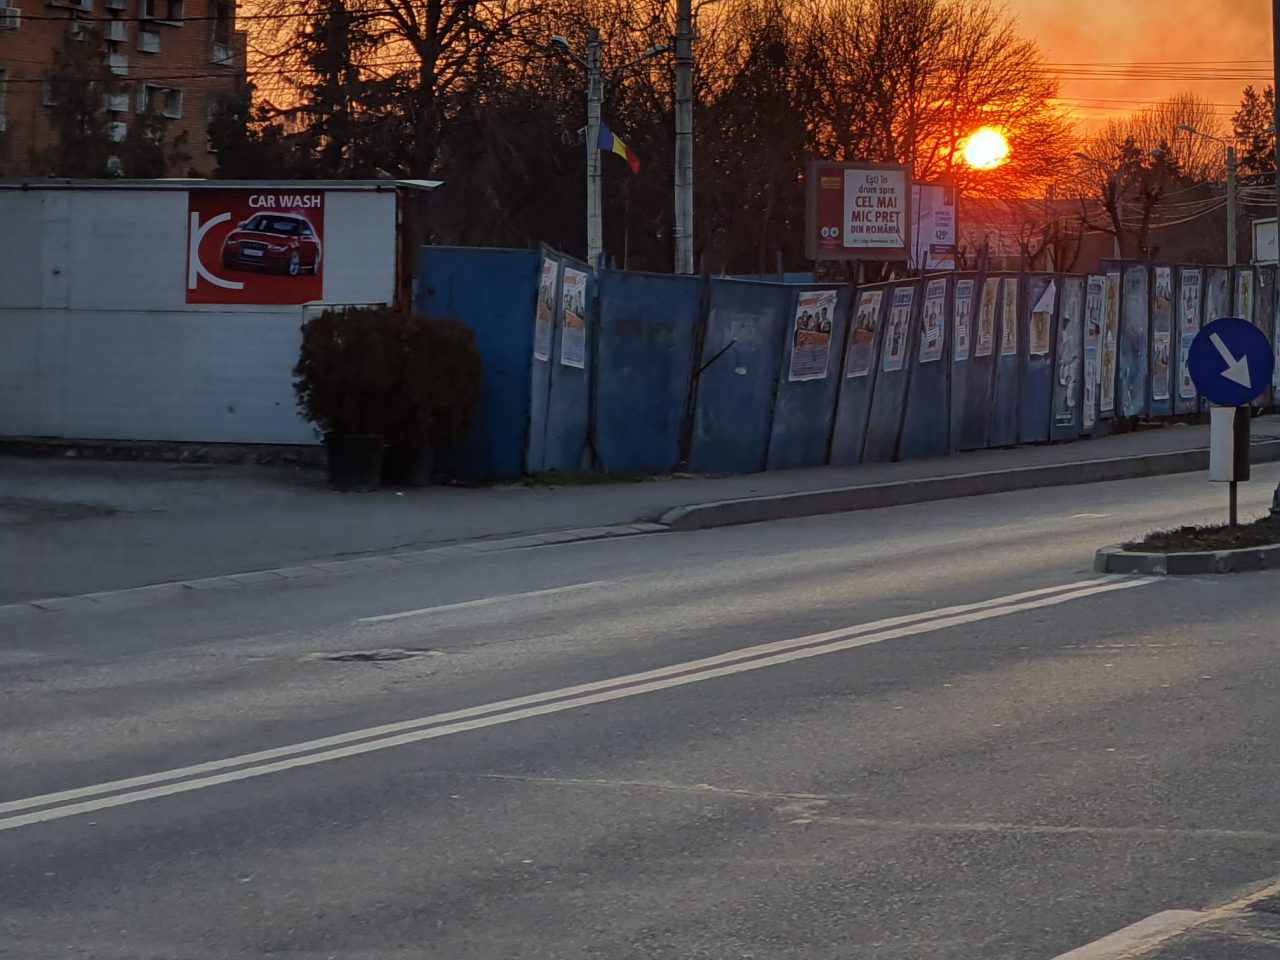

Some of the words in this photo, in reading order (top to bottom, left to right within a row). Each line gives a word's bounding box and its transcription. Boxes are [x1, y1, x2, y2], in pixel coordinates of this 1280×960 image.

[858, 185, 877, 194] drum
[879, 187, 895, 195] spre
[248, 195, 275, 208] CAR
[279, 195, 321, 208] WASH
[855, 196, 874, 208] CEL
[876, 196, 897, 209] MAI
[851, 211, 873, 223] MIC
[850, 226, 864, 234] DIN
